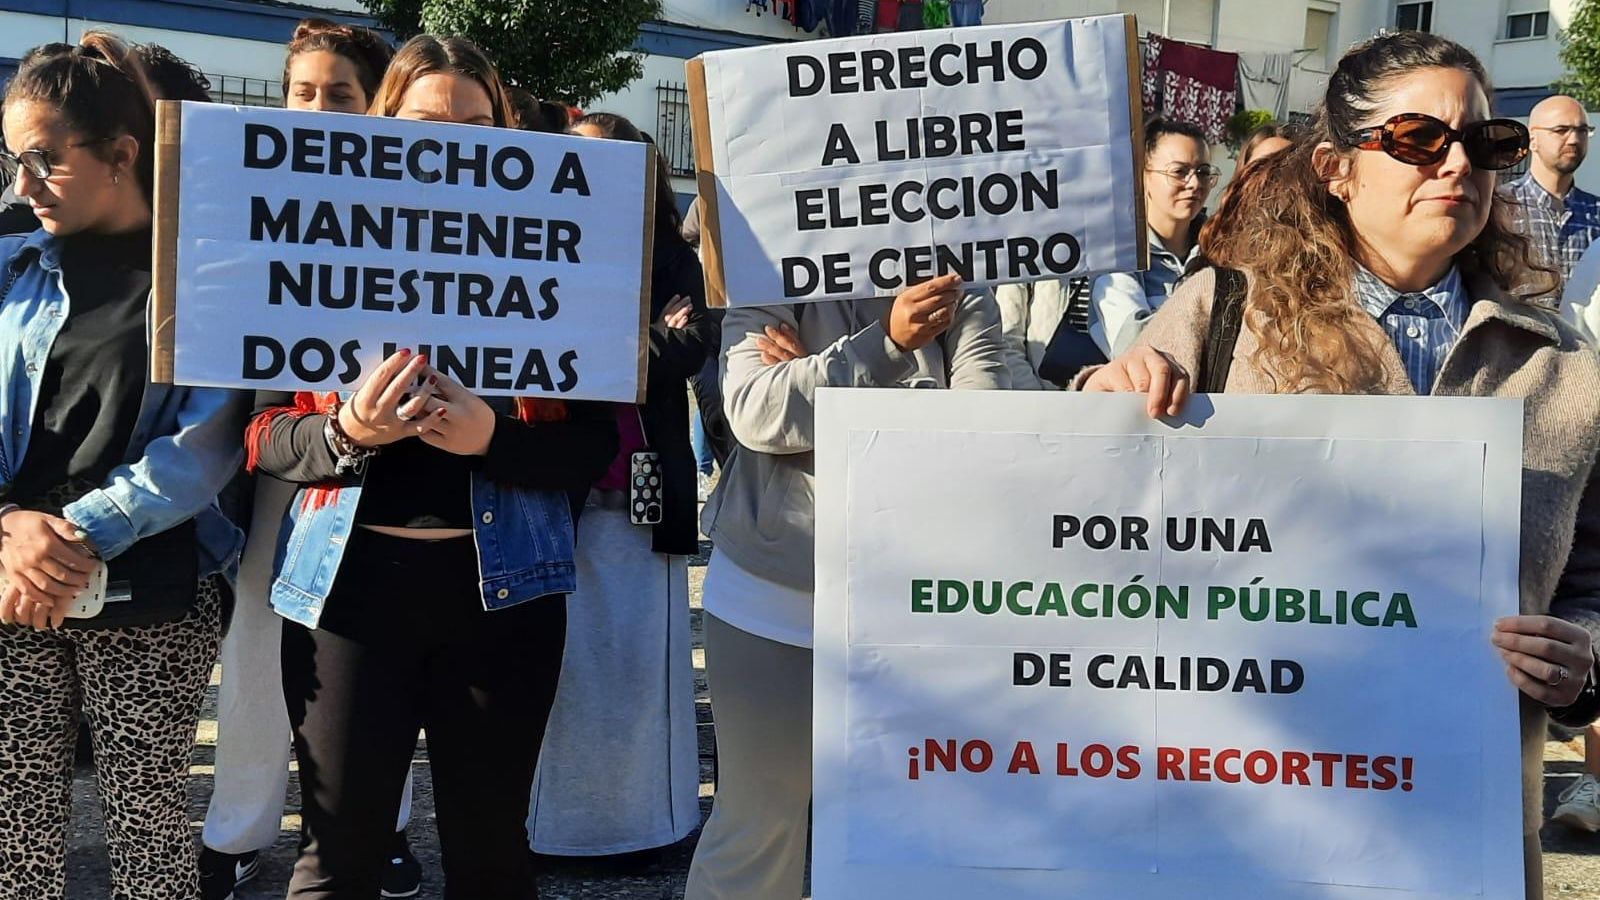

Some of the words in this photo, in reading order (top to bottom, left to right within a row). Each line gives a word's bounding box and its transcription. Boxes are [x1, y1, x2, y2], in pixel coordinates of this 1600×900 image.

[786, 36, 1048, 97] DERECHO
[243, 123, 535, 192] DERECHO
[549, 151, 591, 197] A
[821, 123, 861, 166] A
[875, 109, 1026, 162] LIBRE
[249, 195, 582, 264] MANTENER
[795, 169, 1059, 231] ELECCION
[268, 260, 560, 322] NUESTRAS
[781, 251, 853, 298] DE
[868, 232, 1081, 291] CENTRO
[242, 334, 362, 385] DOS
[1052, 514, 1150, 552] POR
[1166, 517, 1273, 553] UNA
[910, 574, 1189, 619] EDUCACIÓN
[1207, 576, 1418, 628] PÚBLICA
[1013, 652, 1072, 687] DE
[1087, 655, 1305, 695] CALIDAD
[907, 738, 994, 781] ¡NO
[1007, 741, 1041, 775] A
[1056, 742, 1141, 781] LOS
[1156, 747, 1414, 793] RECORTES!
